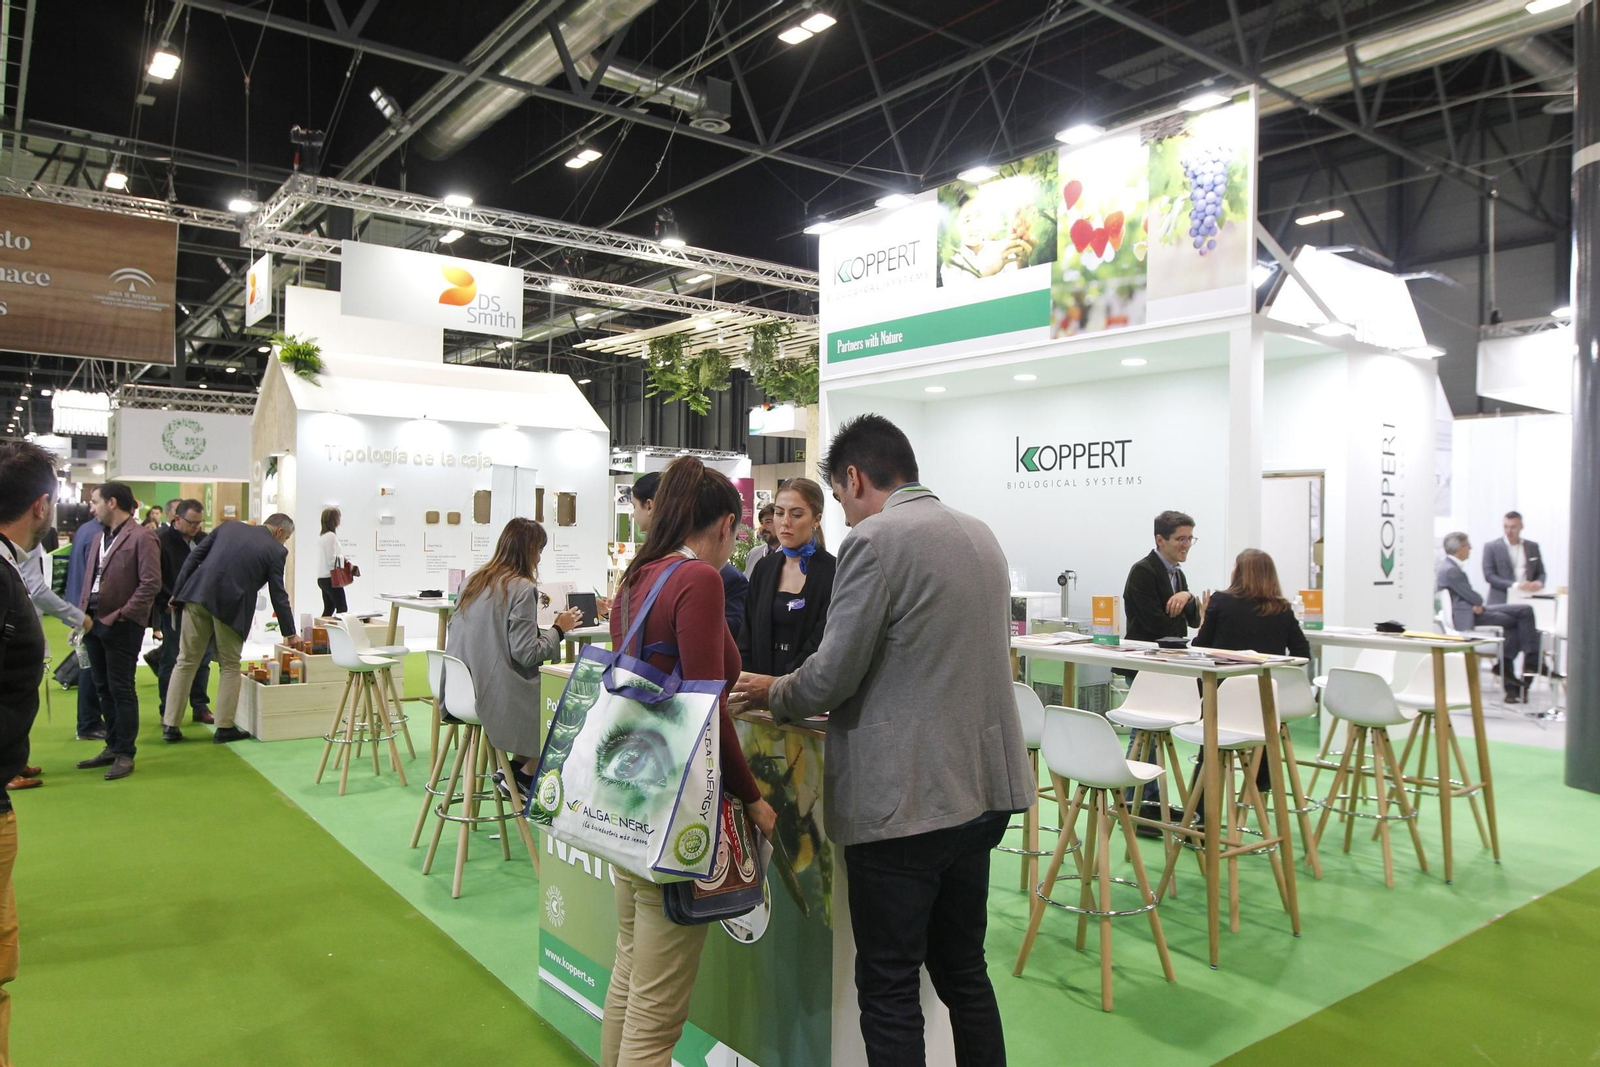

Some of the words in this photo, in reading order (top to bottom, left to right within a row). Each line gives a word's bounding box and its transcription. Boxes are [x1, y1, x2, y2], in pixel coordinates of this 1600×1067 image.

[833, 240, 920, 286] KOPPERT
[478, 293, 501, 312] DS
[467, 306, 516, 329] Smith
[837, 338, 864, 354] Partners
[865, 332, 879, 348] with
[880, 330, 903, 346] Nature
[460, 451, 493, 472] caja
[1016, 436, 1133, 473] KOPPERT
[1006, 479, 1078, 490] BIOLOGICAL
[1085, 476, 1143, 487] SYSTEMS
[544, 947, 595, 987] www.koppert.es
